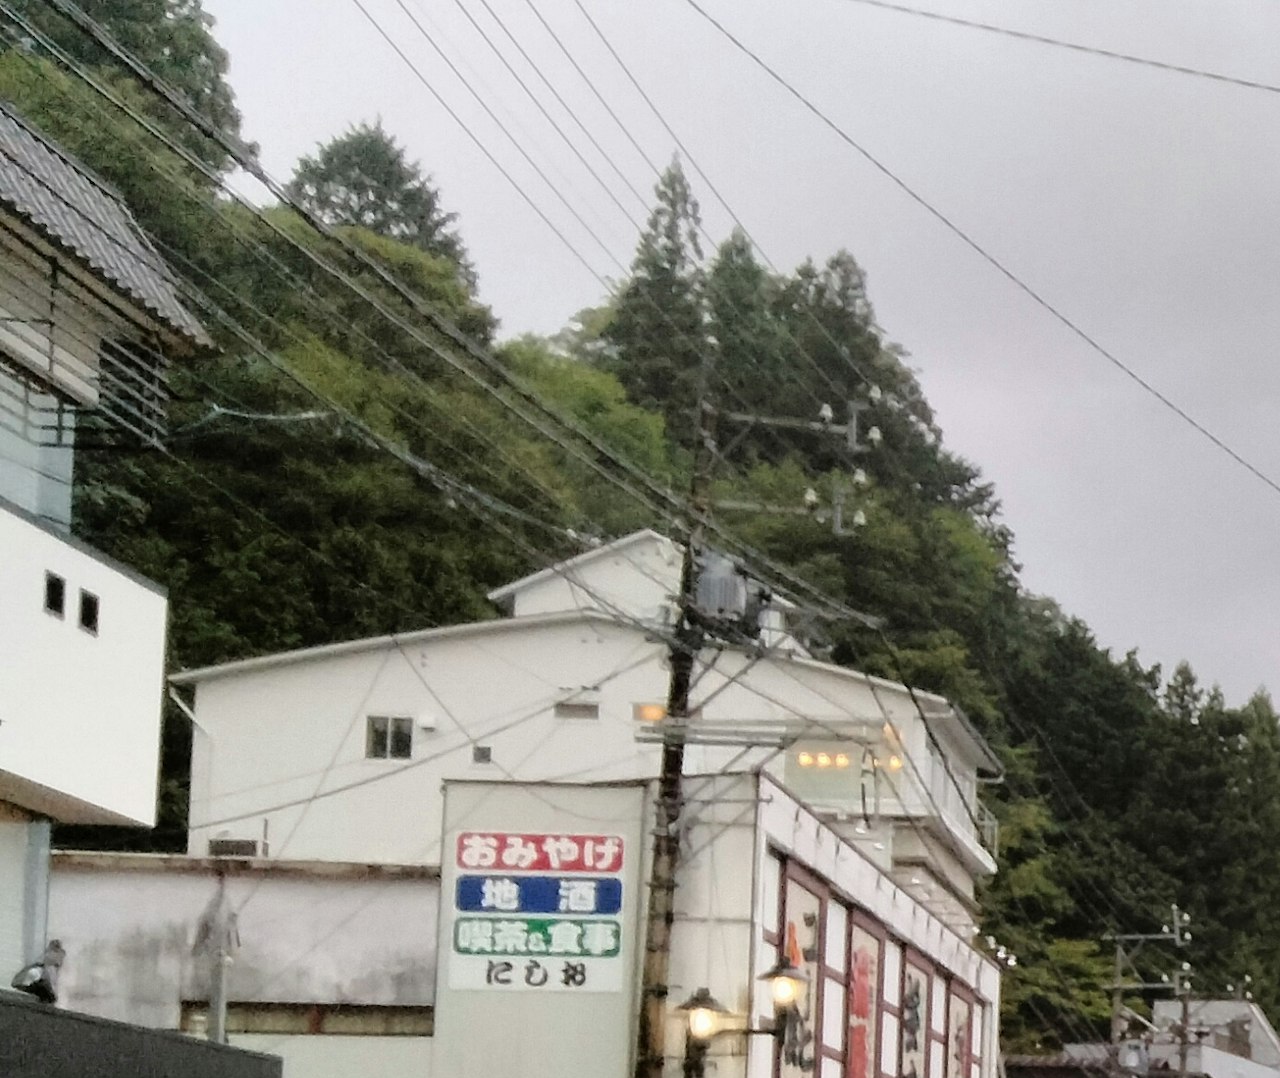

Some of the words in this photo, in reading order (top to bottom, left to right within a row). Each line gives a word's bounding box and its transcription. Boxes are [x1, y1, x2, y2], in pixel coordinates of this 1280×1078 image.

[461, 835, 620, 869] おみやげ
[481, 878, 597, 911] 地酒
